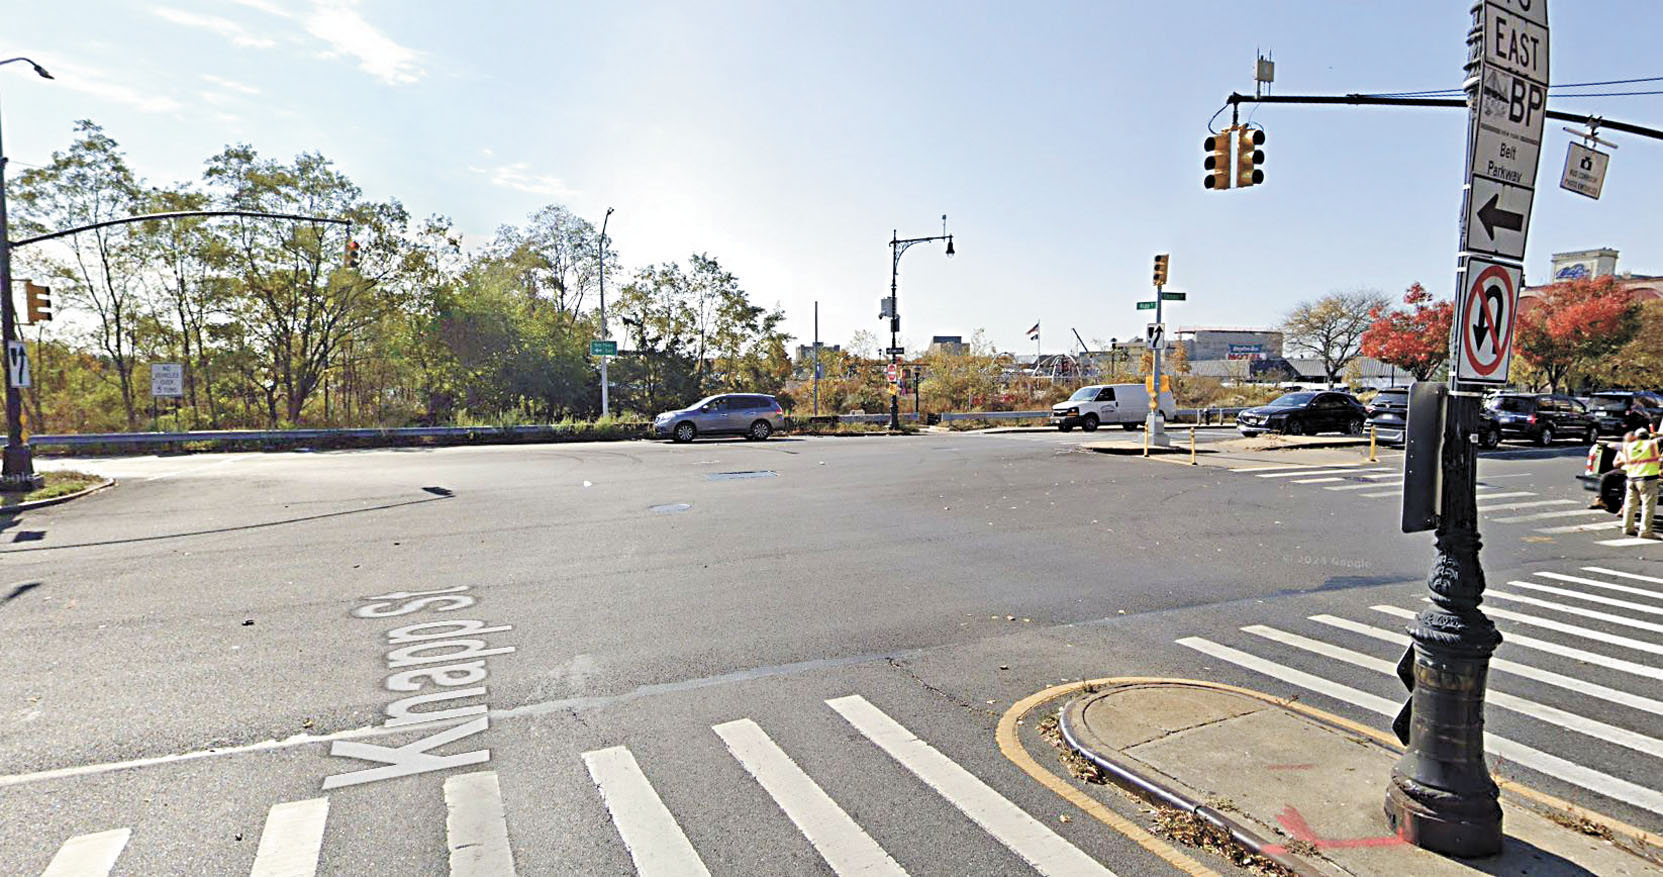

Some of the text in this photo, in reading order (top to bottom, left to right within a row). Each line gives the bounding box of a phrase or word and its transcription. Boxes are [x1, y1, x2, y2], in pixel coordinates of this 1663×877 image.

[1496, 16, 1539, 71] EAST
[1509, 77, 1542, 127] BP
[1500, 142, 1517, 161] Belt
[1488, 160, 1522, 183] Parkway
